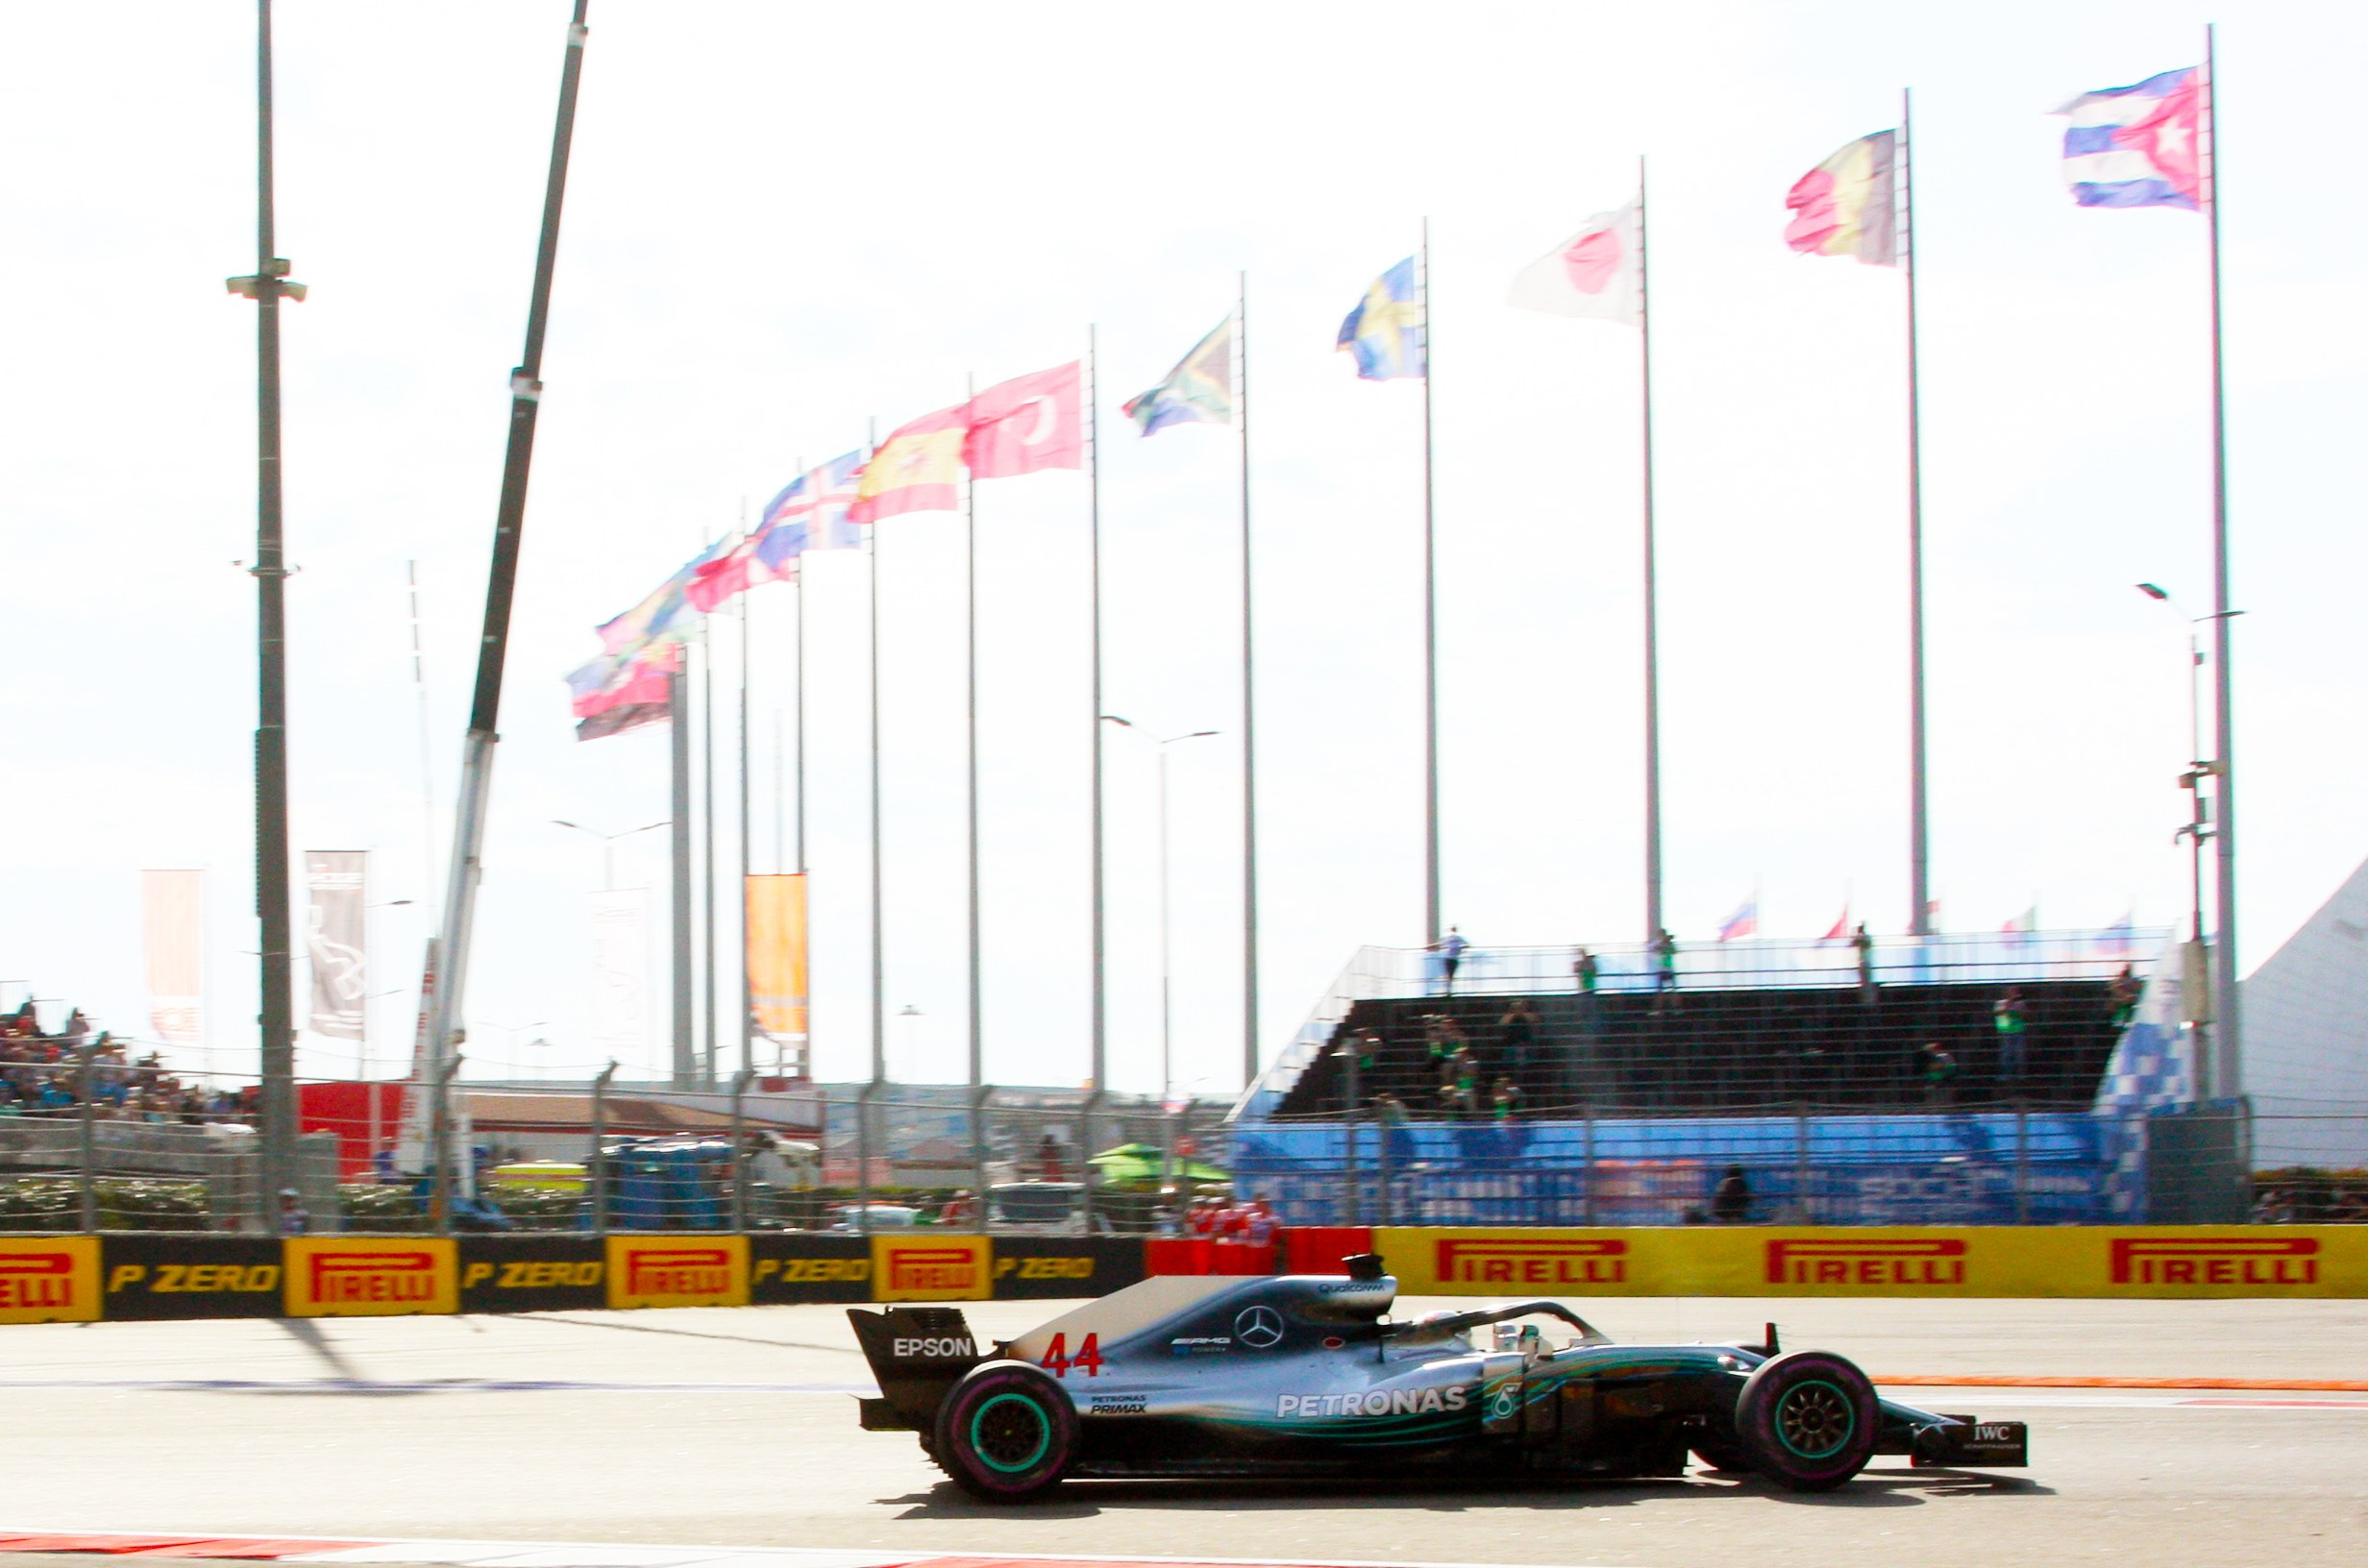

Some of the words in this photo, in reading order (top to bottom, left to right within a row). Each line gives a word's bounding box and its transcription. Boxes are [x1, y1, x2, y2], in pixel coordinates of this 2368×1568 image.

[461, 1262, 496, 1289] P
[495, 1262, 604, 1288] ZERO
[780, 1259, 871, 1283] ZERO
[1435, 1238, 1629, 1283] PIRELLI
[1765, 1238, 1967, 1284] PIRELLI
[2110, 1237, 2320, 1284] PIRELLI
[0, 1253, 74, 1308] ELLI
[107, 1264, 145, 1293] P
[149, 1264, 281, 1293] ZERO
[307, 1253, 436, 1303] PIRELLI
[893, 1336, 973, 1358] EPSON
[1039, 1332, 1104, 1379] 44
[1090, 1402, 1148, 1414] PRIMAX
[1091, 1394, 1147, 1403] PETRONAS
[1275, 1385, 1469, 1418] PETRONAS
[1973, 1425, 2010, 1441] IWC
